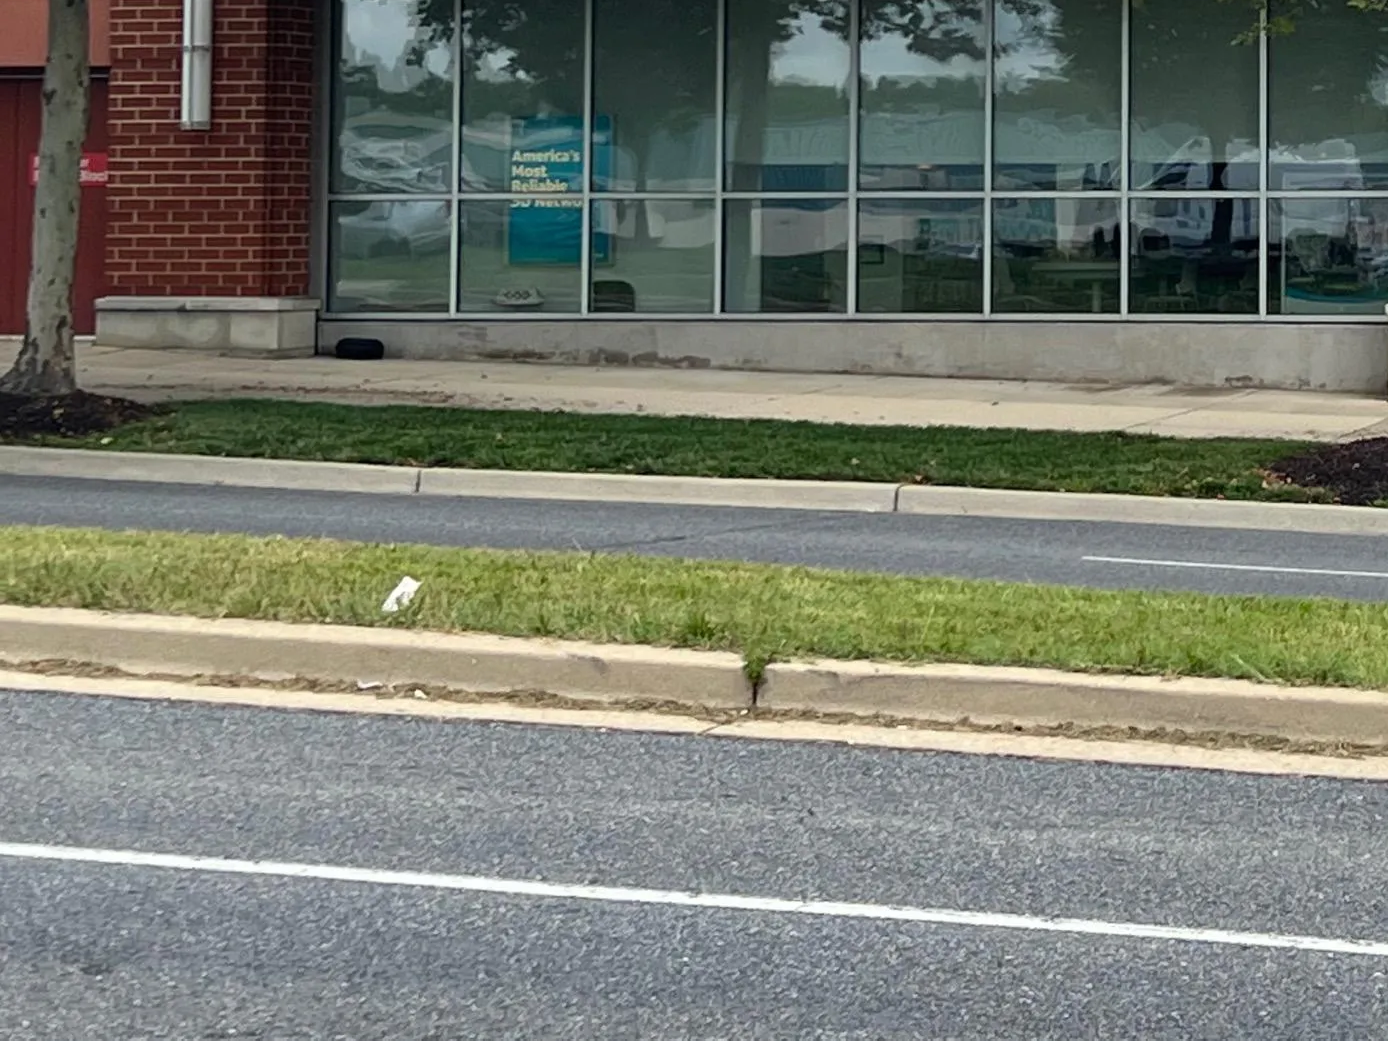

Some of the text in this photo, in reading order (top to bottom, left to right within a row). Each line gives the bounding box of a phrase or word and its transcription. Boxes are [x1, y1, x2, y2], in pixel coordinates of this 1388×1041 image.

[512, 149, 580, 162] America's
[511, 165, 547, 177] Most
[511, 179, 568, 192] Reliable
